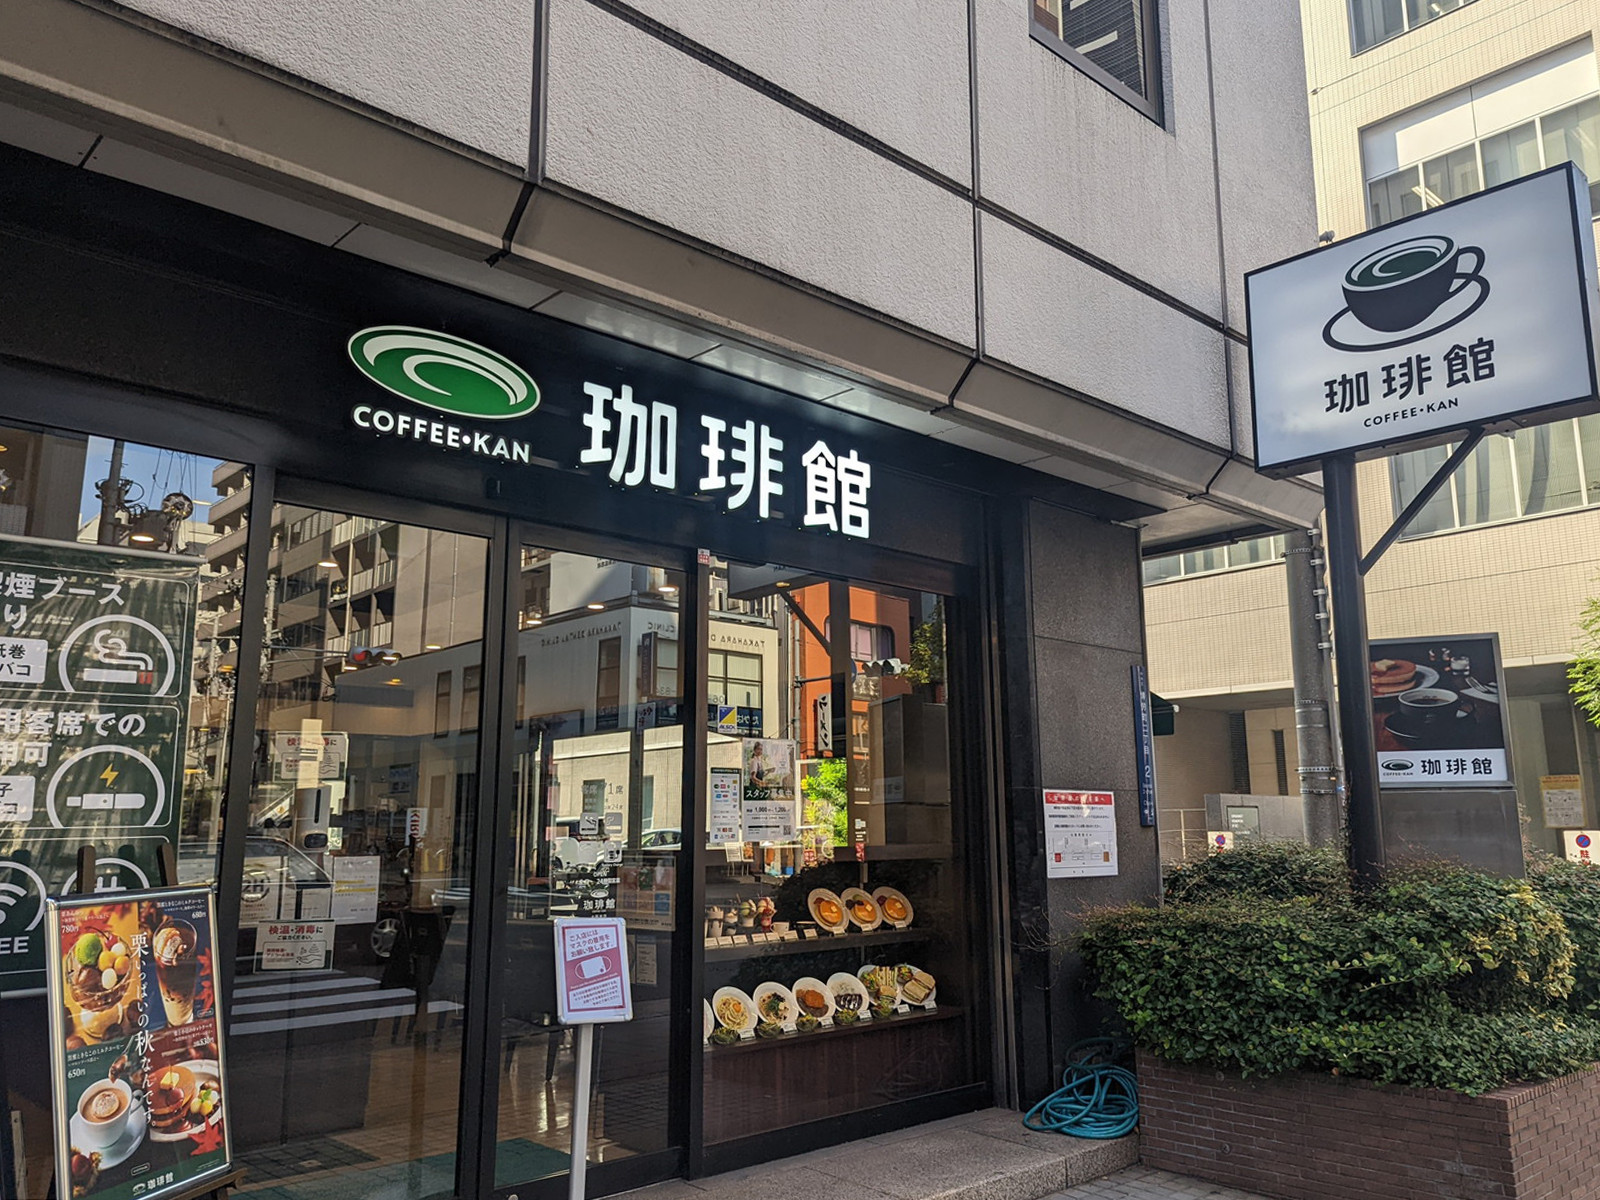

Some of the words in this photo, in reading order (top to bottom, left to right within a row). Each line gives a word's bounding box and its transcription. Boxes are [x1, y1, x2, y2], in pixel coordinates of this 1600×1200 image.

[1324, 337, 1496, 414] 珈琲館
[580, 381, 872, 540] 珈琲館
[0, 571, 125, 607] 煙ブース
[1144, 765, 1151, 778] 2
[1421, 757, 1493, 776] 珈琲館
[583, 898, 616, 911] 珈琲館
[147, 1172, 174, 1191] 珈琲館
